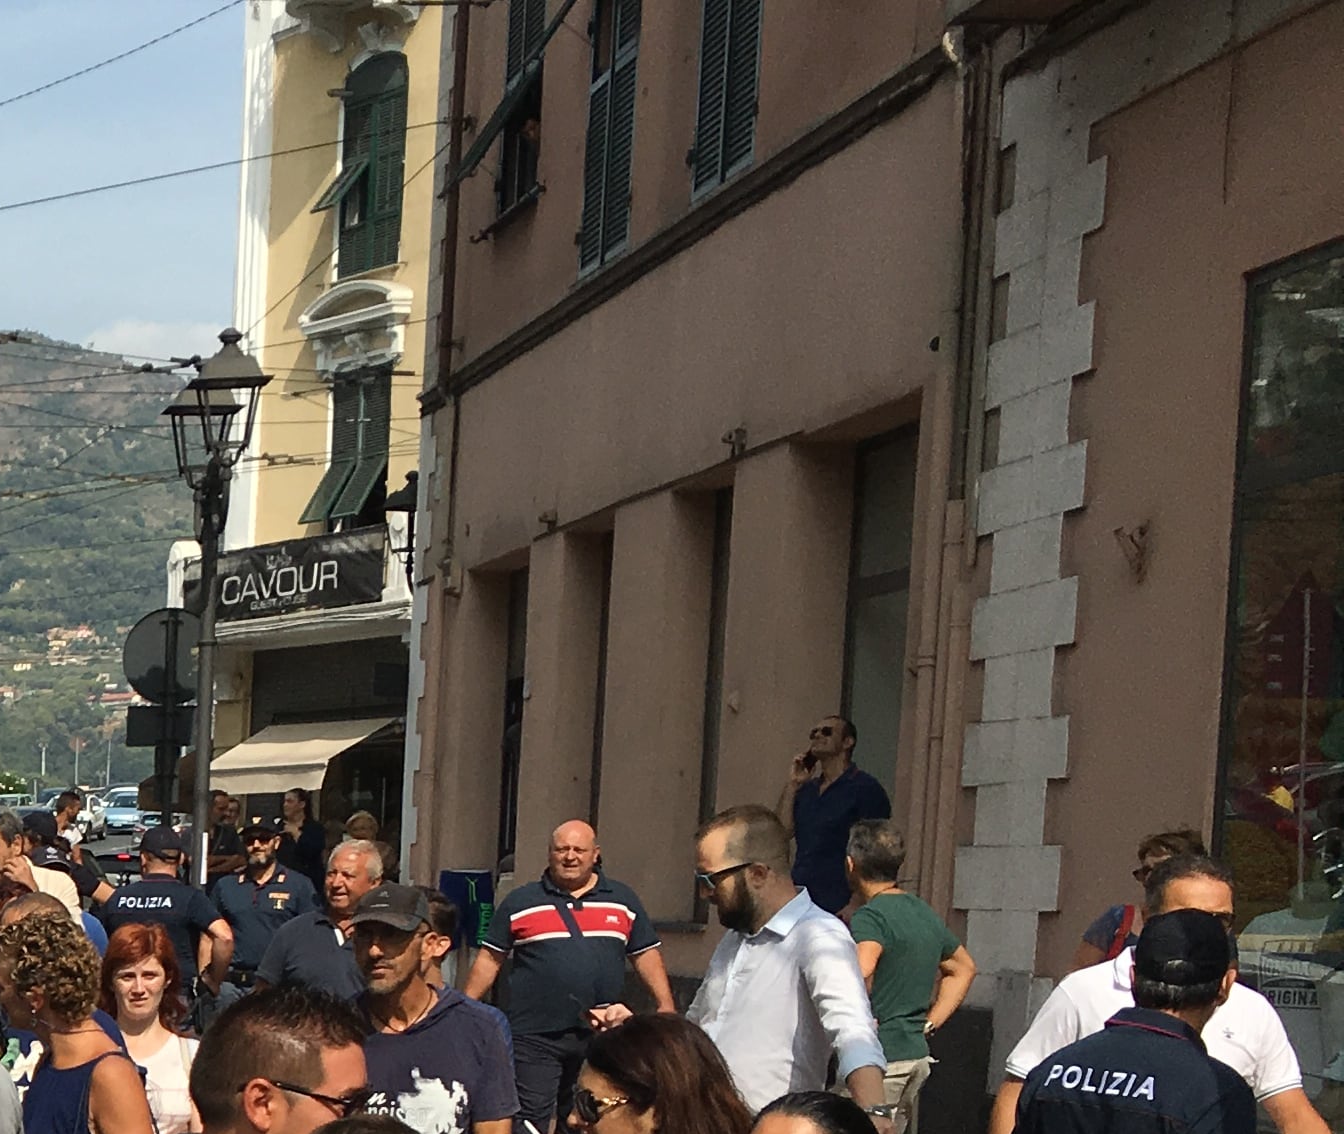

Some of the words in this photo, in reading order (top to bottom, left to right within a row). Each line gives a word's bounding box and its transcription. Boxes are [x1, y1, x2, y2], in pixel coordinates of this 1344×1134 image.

[221, 560, 338, 605] CAVOUR
[118, 896, 172, 909] POLIZIA
[1265, 988, 1319, 1006] RIGINA
[1043, 1064, 1156, 1101] POLIZIA
